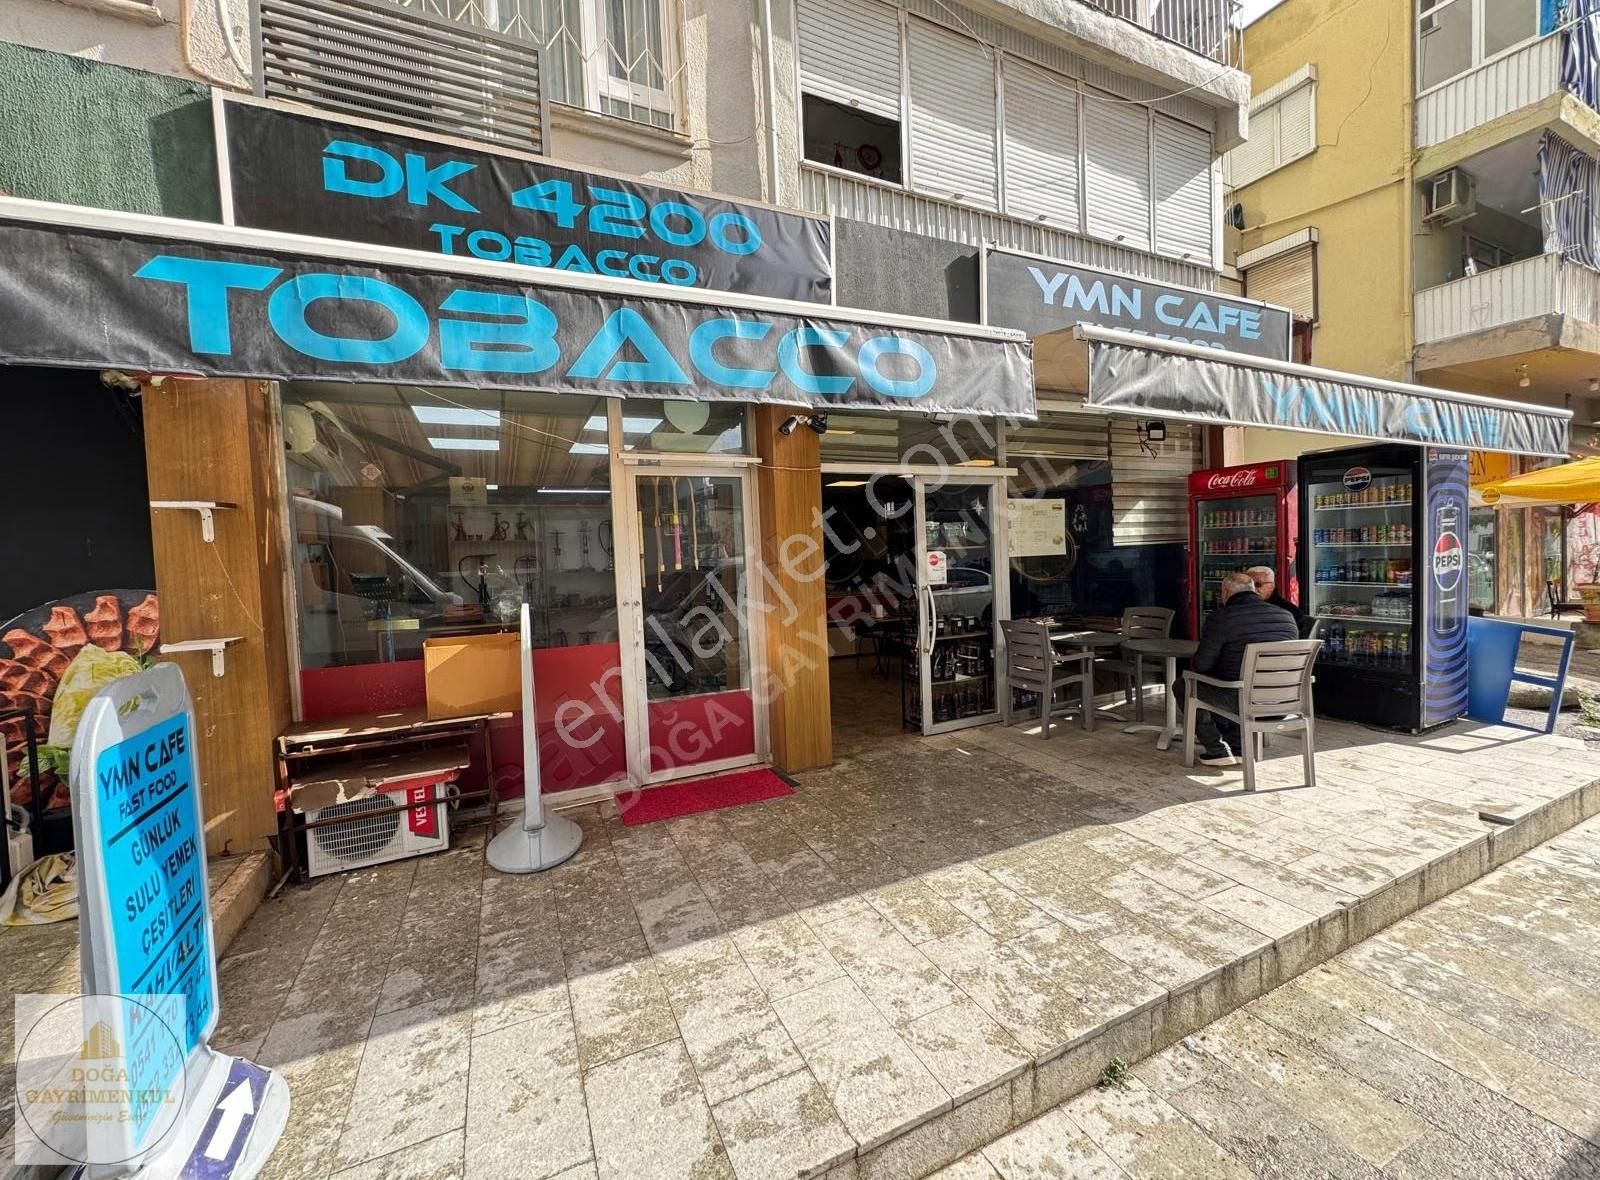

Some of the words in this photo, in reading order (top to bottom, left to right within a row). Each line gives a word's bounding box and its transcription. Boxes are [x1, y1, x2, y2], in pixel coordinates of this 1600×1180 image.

[322, 140, 481, 214] DK
[511, 179, 763, 256] 4200
[428, 223, 698, 288] TOBACCO
[133, 255, 938, 399] TOBACCO
[1027, 266, 1142, 320] YMN
[1154, 294, 1262, 340] CAFE
[1262, 379, 1378, 438] YMN
[1207, 469, 1258, 490] Coca-Cola
[1435, 554, 1461, 568] PEPSI
[99, 751, 141, 800] YMN
[144, 726, 185, 773] CAFE
[119, 788, 146, 821] FAST
[148, 769, 177, 801] FOOD
[131, 808, 181, 866] GÜNLÜK
[125, 869, 161, 923] SULU
[161, 831, 198, 884] YEMEK
